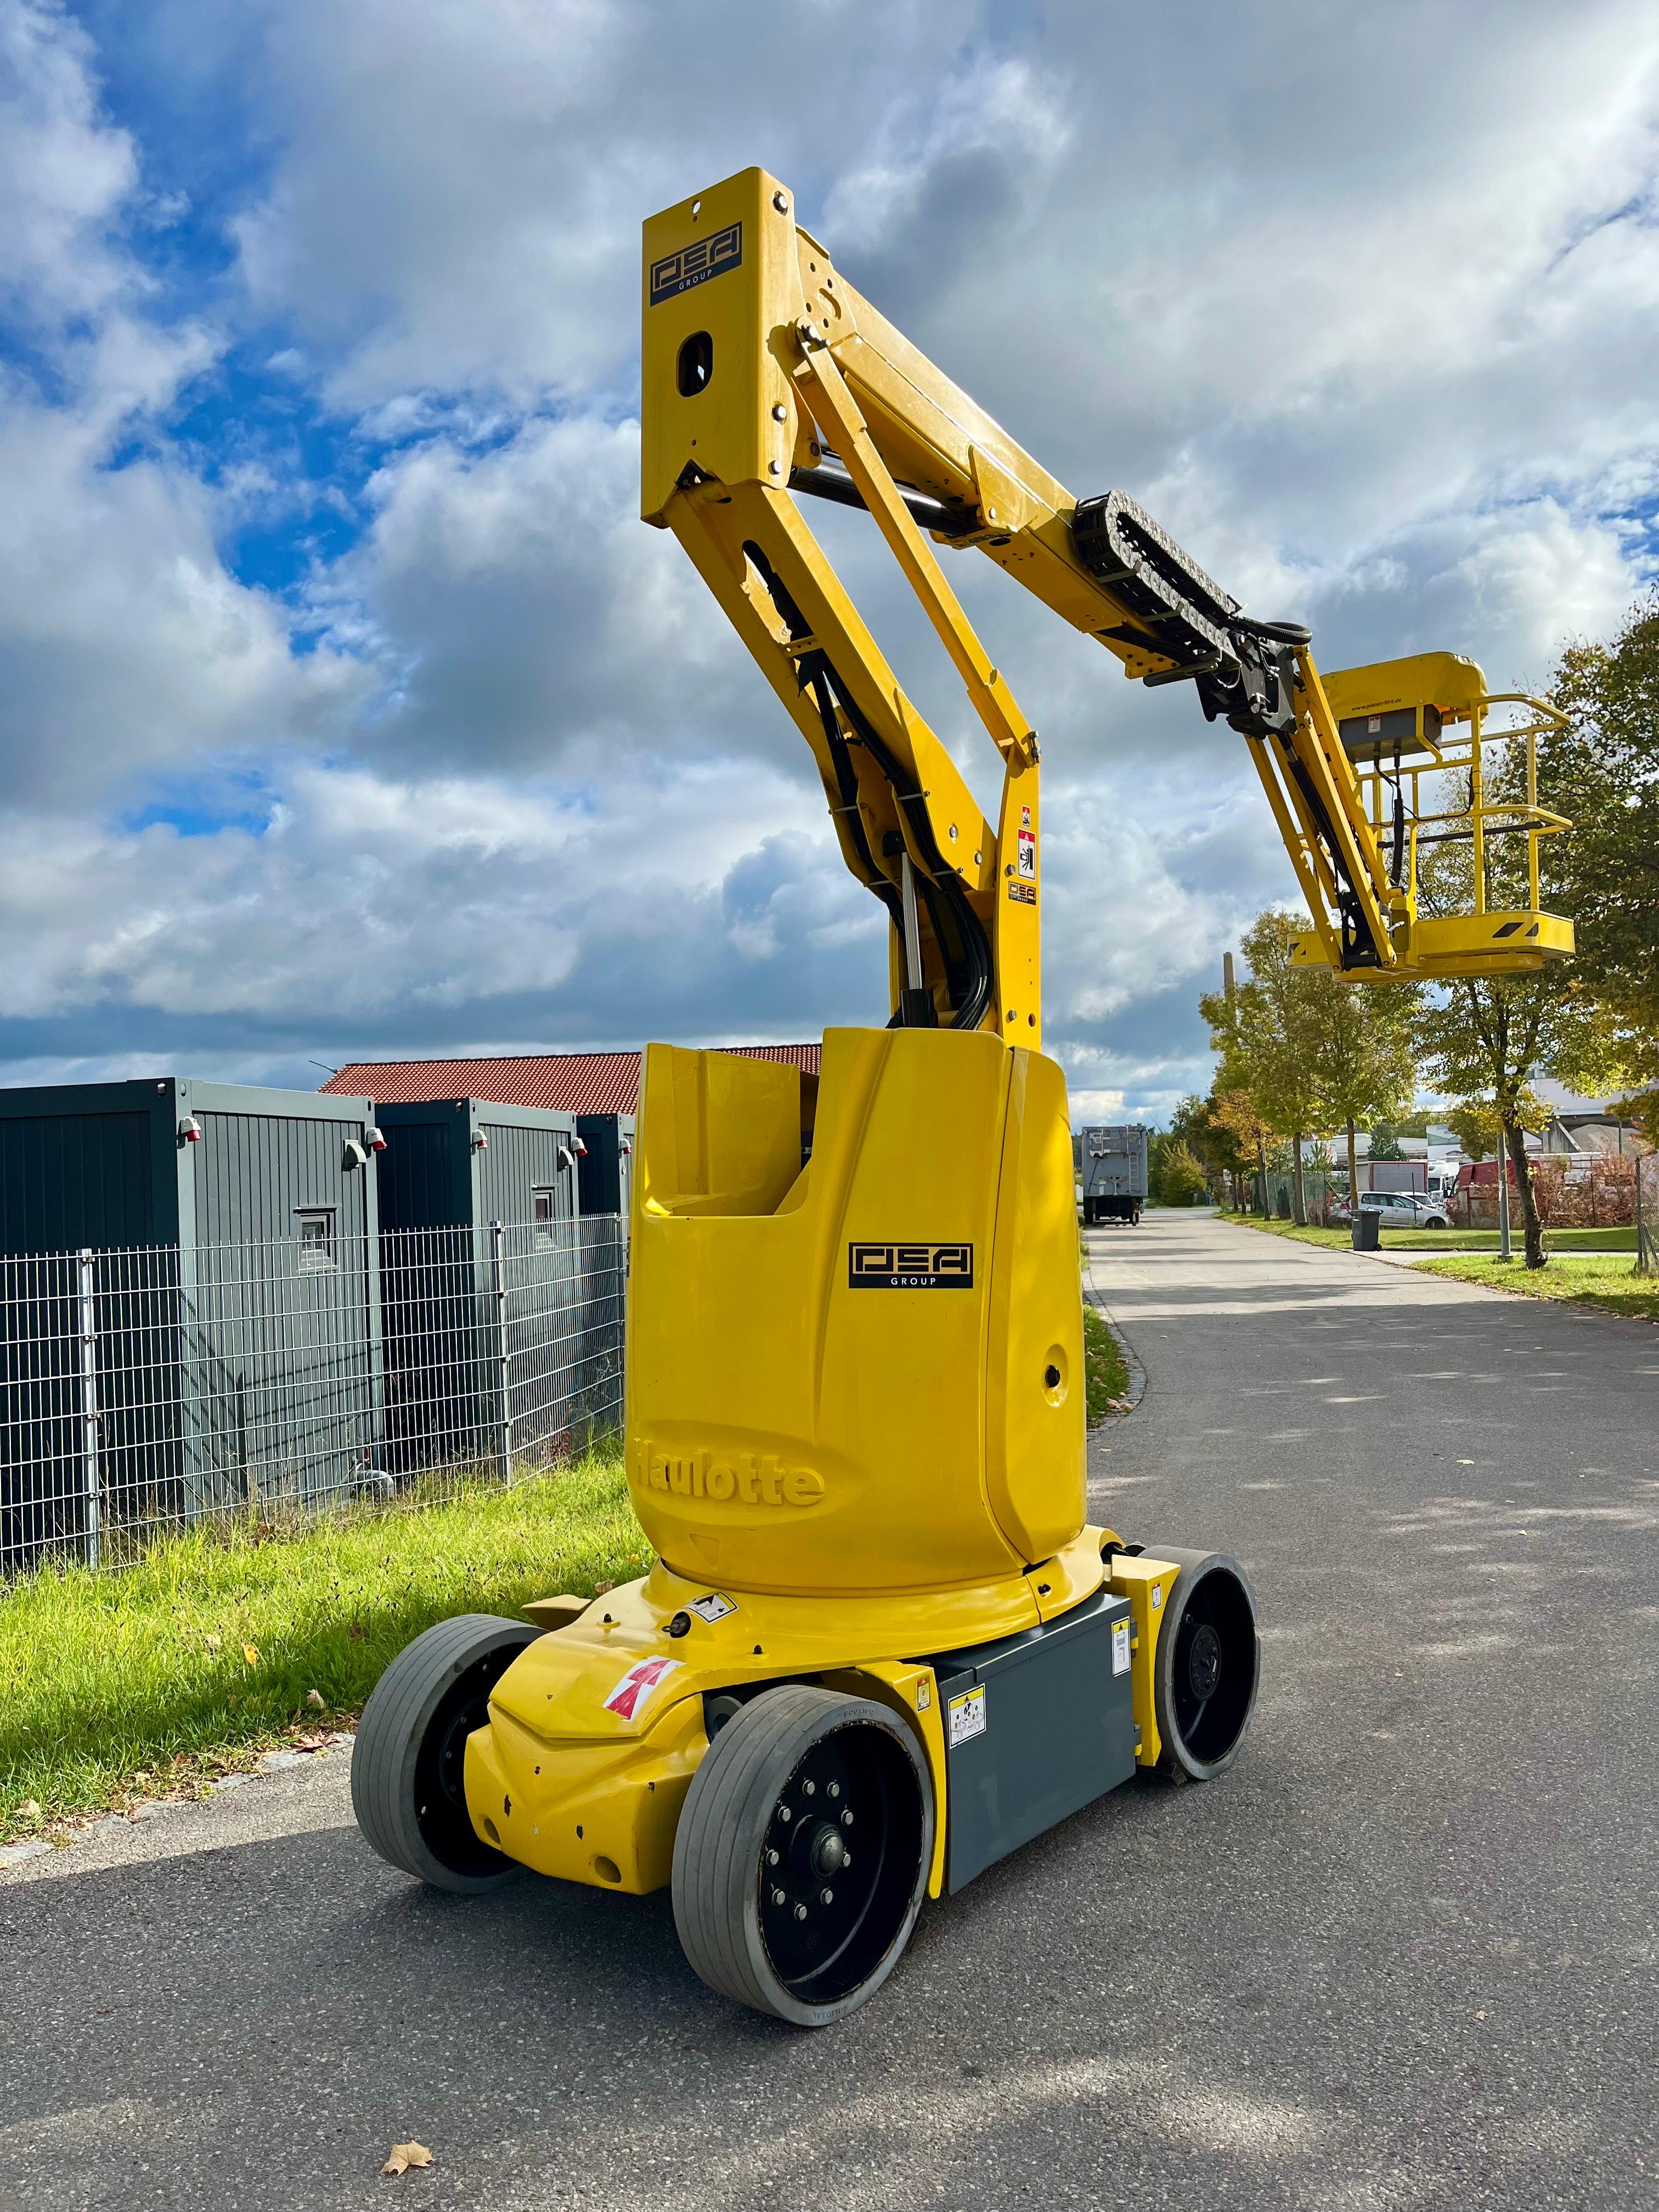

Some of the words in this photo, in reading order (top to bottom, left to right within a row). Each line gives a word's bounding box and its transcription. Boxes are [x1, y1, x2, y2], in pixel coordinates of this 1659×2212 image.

[678, 269, 713, 290] GROUP
[890, 1277, 936, 1285] GROUP
[633, 1436, 825, 1506] Haulotte
